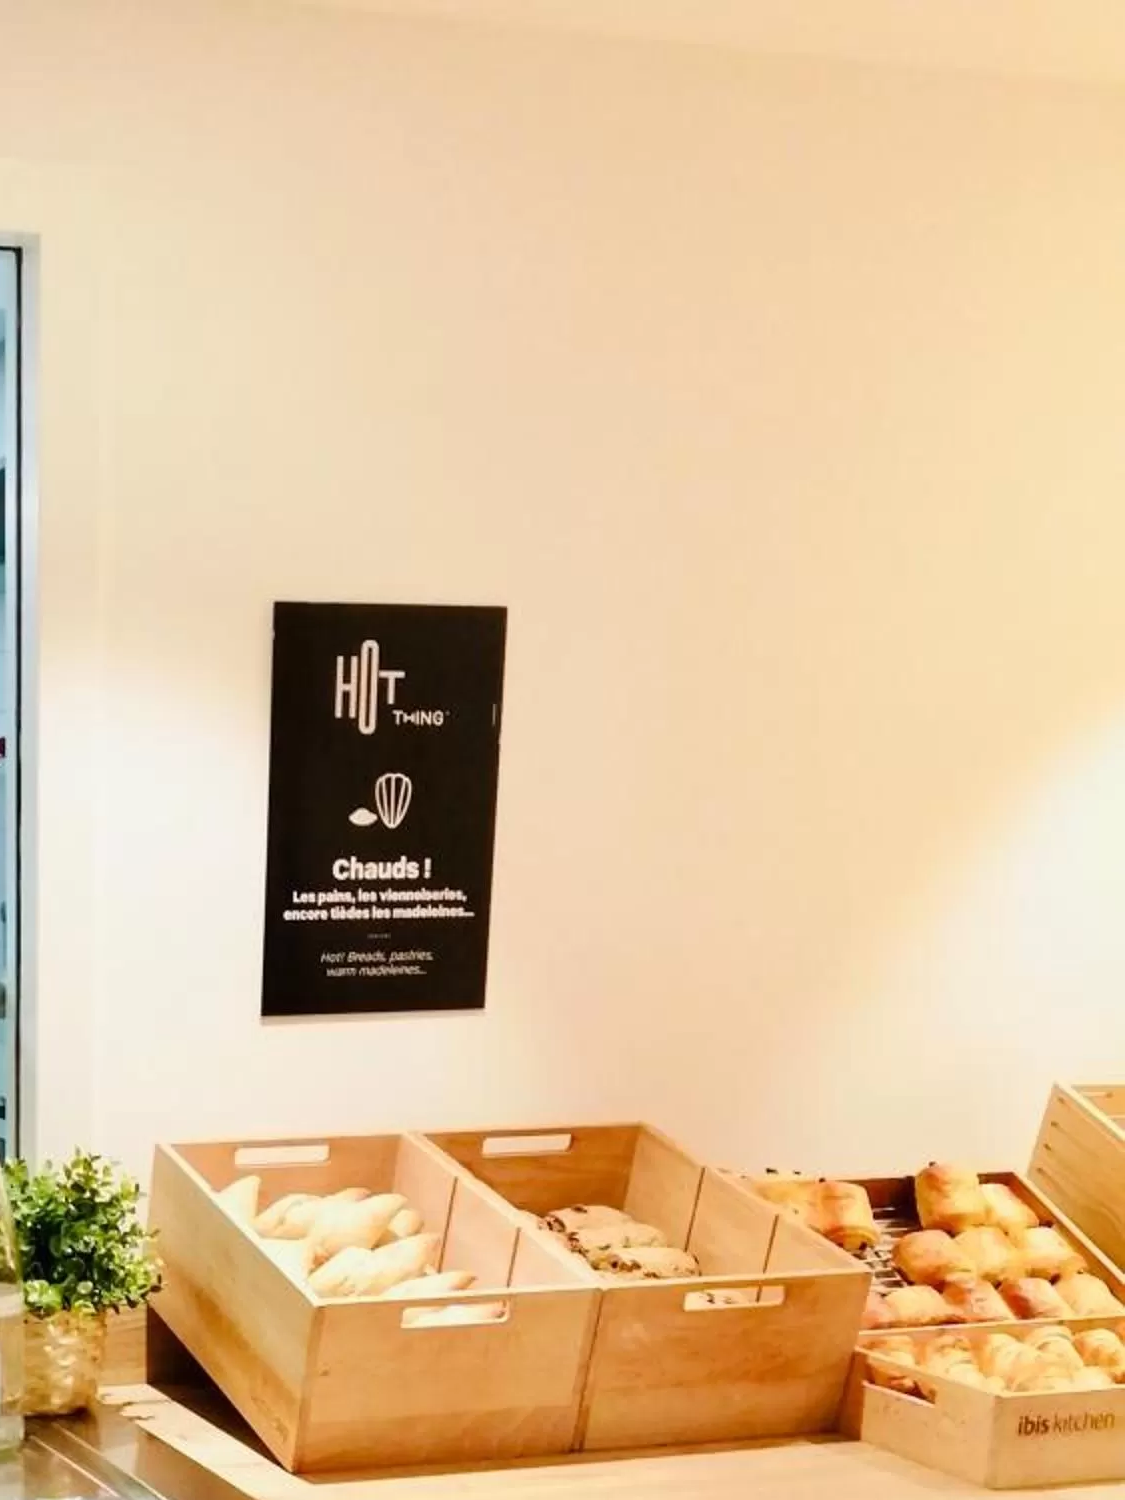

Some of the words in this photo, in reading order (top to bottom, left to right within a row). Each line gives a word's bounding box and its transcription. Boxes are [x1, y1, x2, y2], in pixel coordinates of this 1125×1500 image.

[335, 639, 406, 735] HOT
[332, 855, 420, 881] Chauds
[423, 857, 432, 879] !
[292, 890, 316, 904] Les
[357, 887, 377, 903] les
[283, 908, 328, 921] encore
[371, 905, 391, 919] les
[1018, 1415, 1049, 1436] ibis
[1052, 1411, 1115, 1433] kitchen
